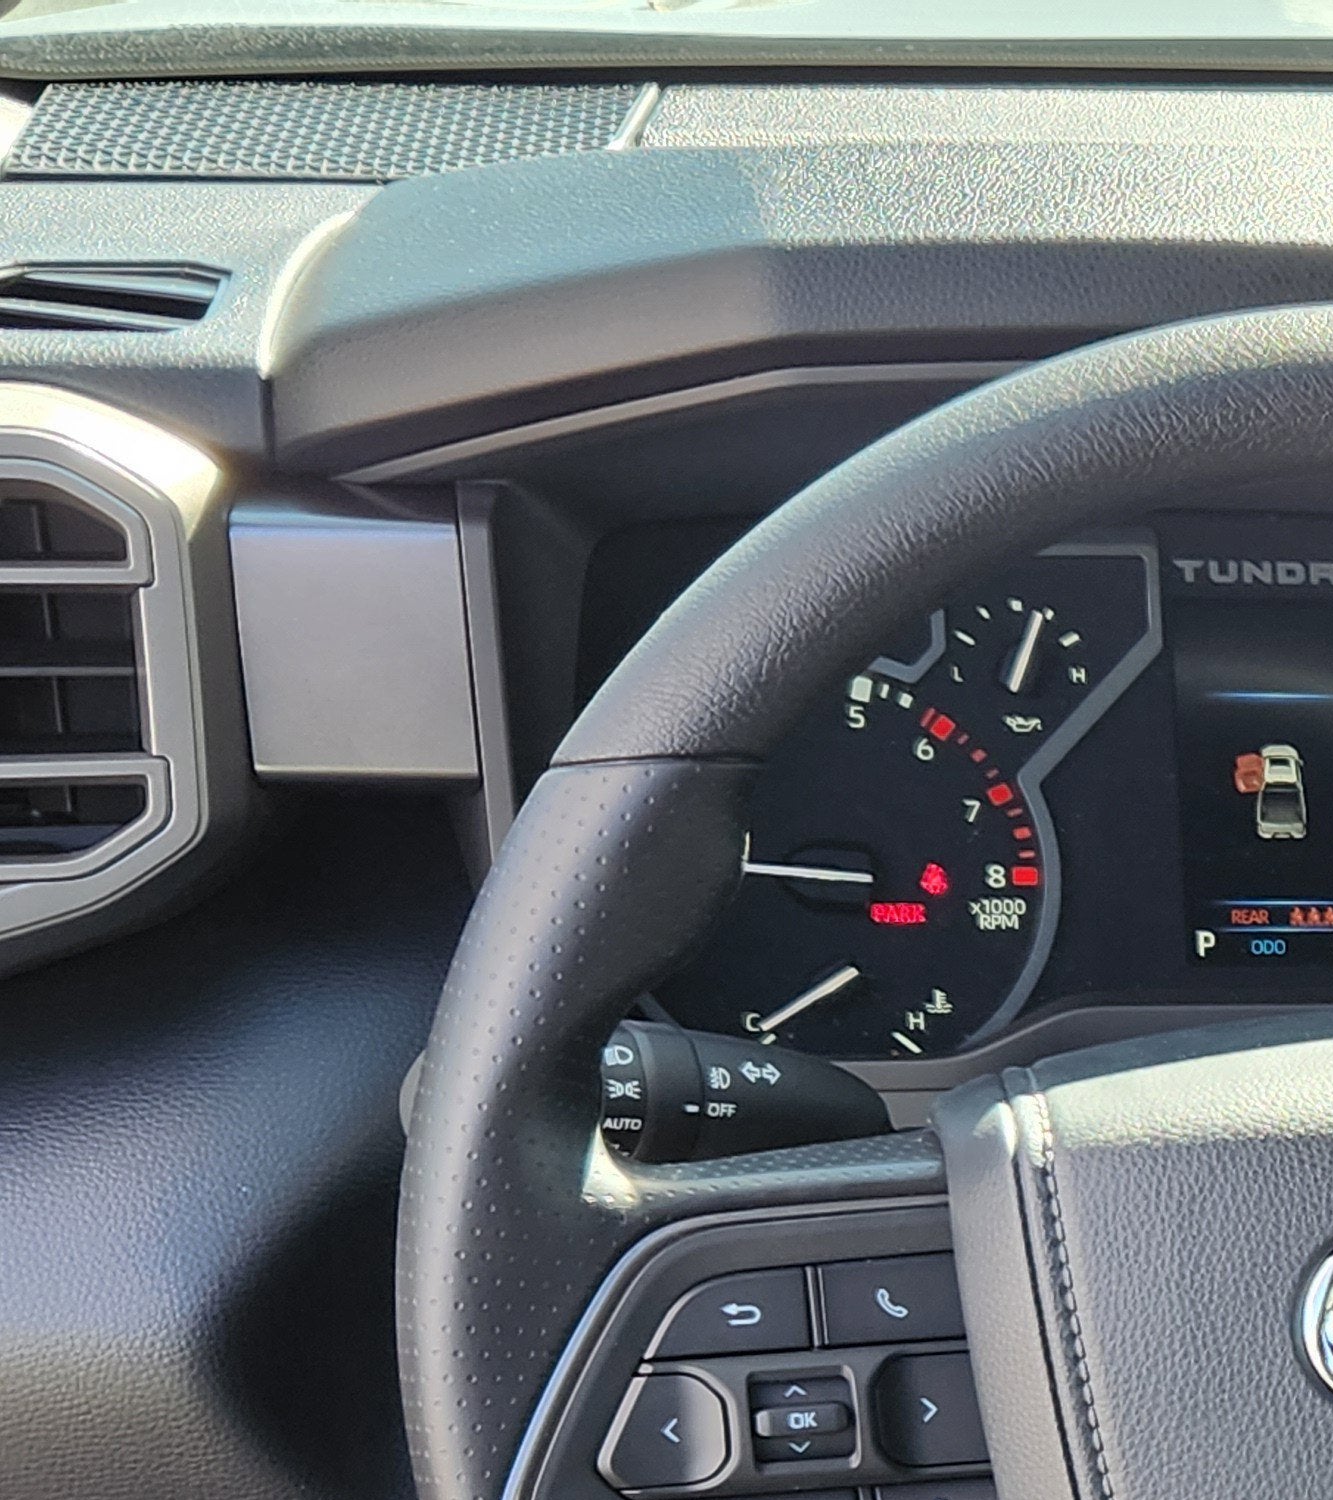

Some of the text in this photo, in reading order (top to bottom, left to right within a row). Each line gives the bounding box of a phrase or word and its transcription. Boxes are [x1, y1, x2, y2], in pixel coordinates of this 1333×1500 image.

[952, 665, 964, 683] L
[1070, 667, 1088, 684] H
[847, 705, 866, 729] 5
[915, 738, 935, 761] 6
[962, 799, 982, 823] 7
[985, 863, 1006, 888] 8
[870, 902, 927, 924] PARK
[969, 897, 1027, 915] x1000
[978, 913, 1019, 930] RPM
[1230, 909, 1270, 925] REAR
[1195, 930, 1216, 957] P
[1251, 939, 1286, 955] ODO
[745, 1012, 761, 1032] C
[906, 1011, 925, 1031] H
[707, 1103, 738, 1117] OFF
[602, 1118, 642, 1130] AUTO
[788, 1412, 818, 1429] OK
